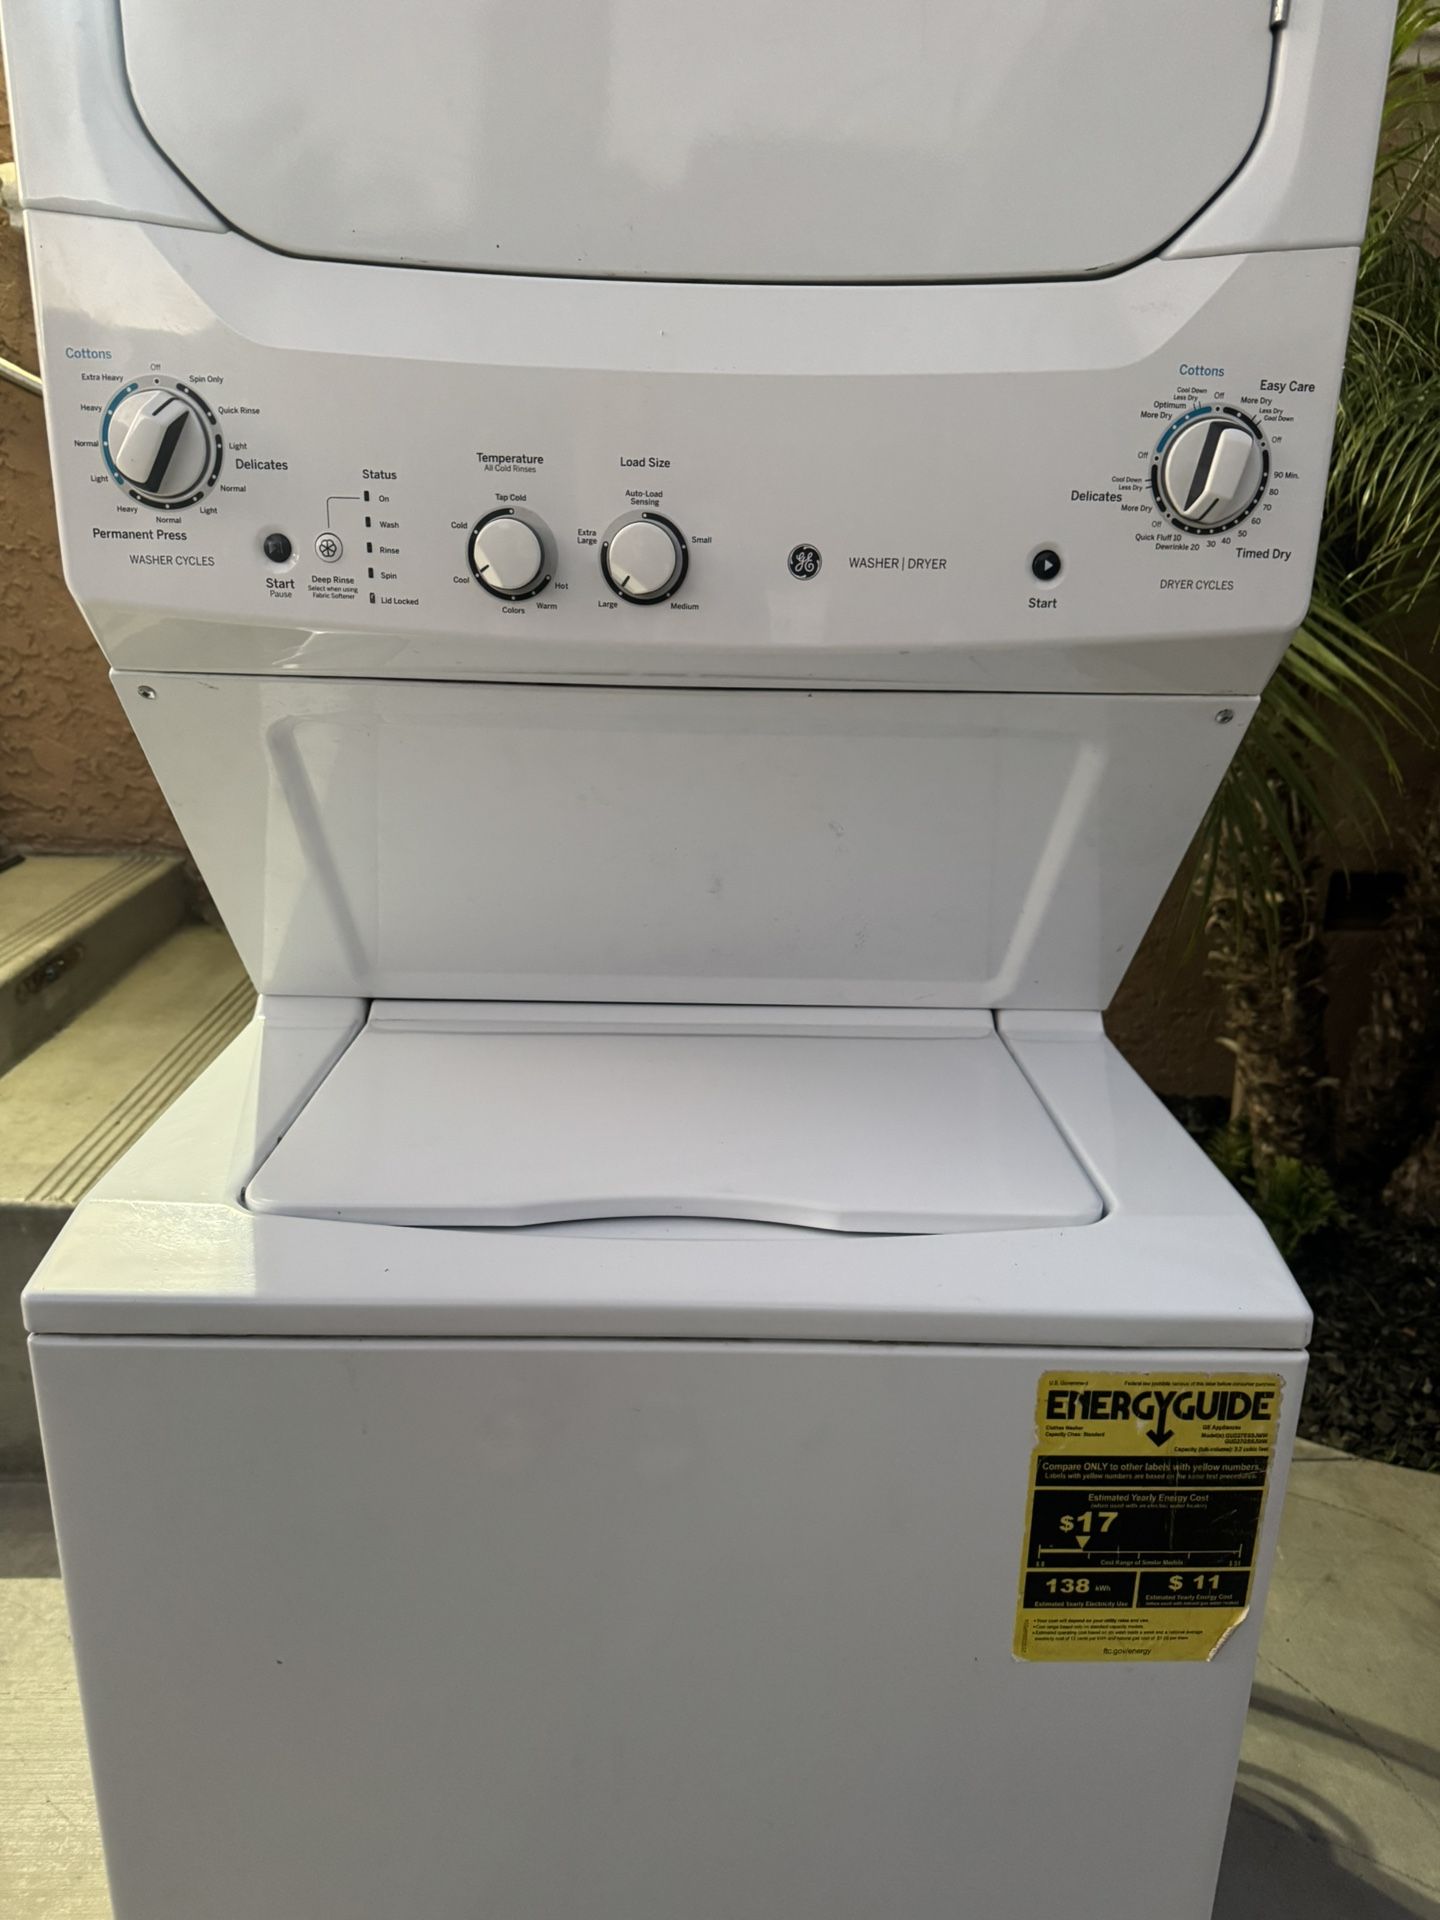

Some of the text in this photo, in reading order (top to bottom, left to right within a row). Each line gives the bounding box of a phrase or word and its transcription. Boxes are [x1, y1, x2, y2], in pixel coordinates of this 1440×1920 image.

[65, 347, 112, 360] Cottons
[1179, 364, 1225, 377] Cottons
[81, 373, 123, 383] Extra Heavy
[189, 376, 223, 385] Spin Only
[1260, 380, 1315, 392] Easy Care
[1214, 391, 1225, 399] Off
[1153, 401, 1187, 410] Optimum
[1260, 397, 1272, 406] Dry
[80, 404, 102, 413] Heavy
[218, 407, 236, 415] Quick
[1140, 411, 1173, 420] More Dry
[229, 442, 247, 451] Light
[476, 452, 544, 465] Temperature
[620, 457, 670, 468] Load Size
[235, 459, 288, 470] Delicates
[513, 465, 536, 473] Rinses
[362, 469, 397, 480] Status
[90, 475, 108, 484] Light
[625, 490, 663, 498] Auto-Load
[1071, 490, 1122, 502] Delicates
[1269, 488, 1279, 496] 80
[495, 493, 508, 502] Tap
[630, 498, 659, 507] Sensing
[117, 506, 138, 514] Heavy
[200, 506, 218, 515] Light
[1121, 504, 1152, 514] More Dry
[156, 516, 182, 524] Normal
[451, 521, 467, 529] Cold
[92, 528, 187, 541] Permanent Press
[577, 529, 596, 537] Extra
[1135, 533, 1155, 542] Quick
[1156, 534, 1172, 542] Fluff
[577, 537, 597, 546] Large
[692, 536, 712, 544] Small
[1190, 543, 1199, 551] 20
[1235, 548, 1292, 562] Timed Dry
[129, 555, 215, 566] WASHER CYCLES
[849, 557, 947, 570] WASHER DRYER
[311, 576, 331, 584] Deep
[381, 572, 397, 580] Spin
[453, 576, 469, 584] Cool
[266, 578, 295, 589] Start
[555, 582, 568, 590] Hot
[1160, 579, 1234, 590] DRYER CYCLES
[270, 590, 292, 598] Pause
[537, 602, 557, 610] Warm
[598, 601, 618, 610] Large
[670, 602, 699, 610] Medium
[1028, 598, 1057, 608] Start
[502, 606, 525, 615] Colors
[1046, 1390, 1275, 1421] ENERGYGUIDE
[1042, 1463, 1081, 1473] Compare
[1083, 1463, 1108, 1471] ONLY
[1109, 1463, 1116, 1471] to
[1118, 1463, 1143, 1471] other
[1192, 1464, 1220, 1473] yellow
[1088, 1494, 1129, 1502] Estimated
[1131, 1494, 1156, 1503] Yearly
[1159, 1494, 1187, 1503] Energy
[1059, 1512, 1119, 1532] $17
[1046, 1578, 1090, 1593] 138
[1193, 1575, 1220, 1589] 11
